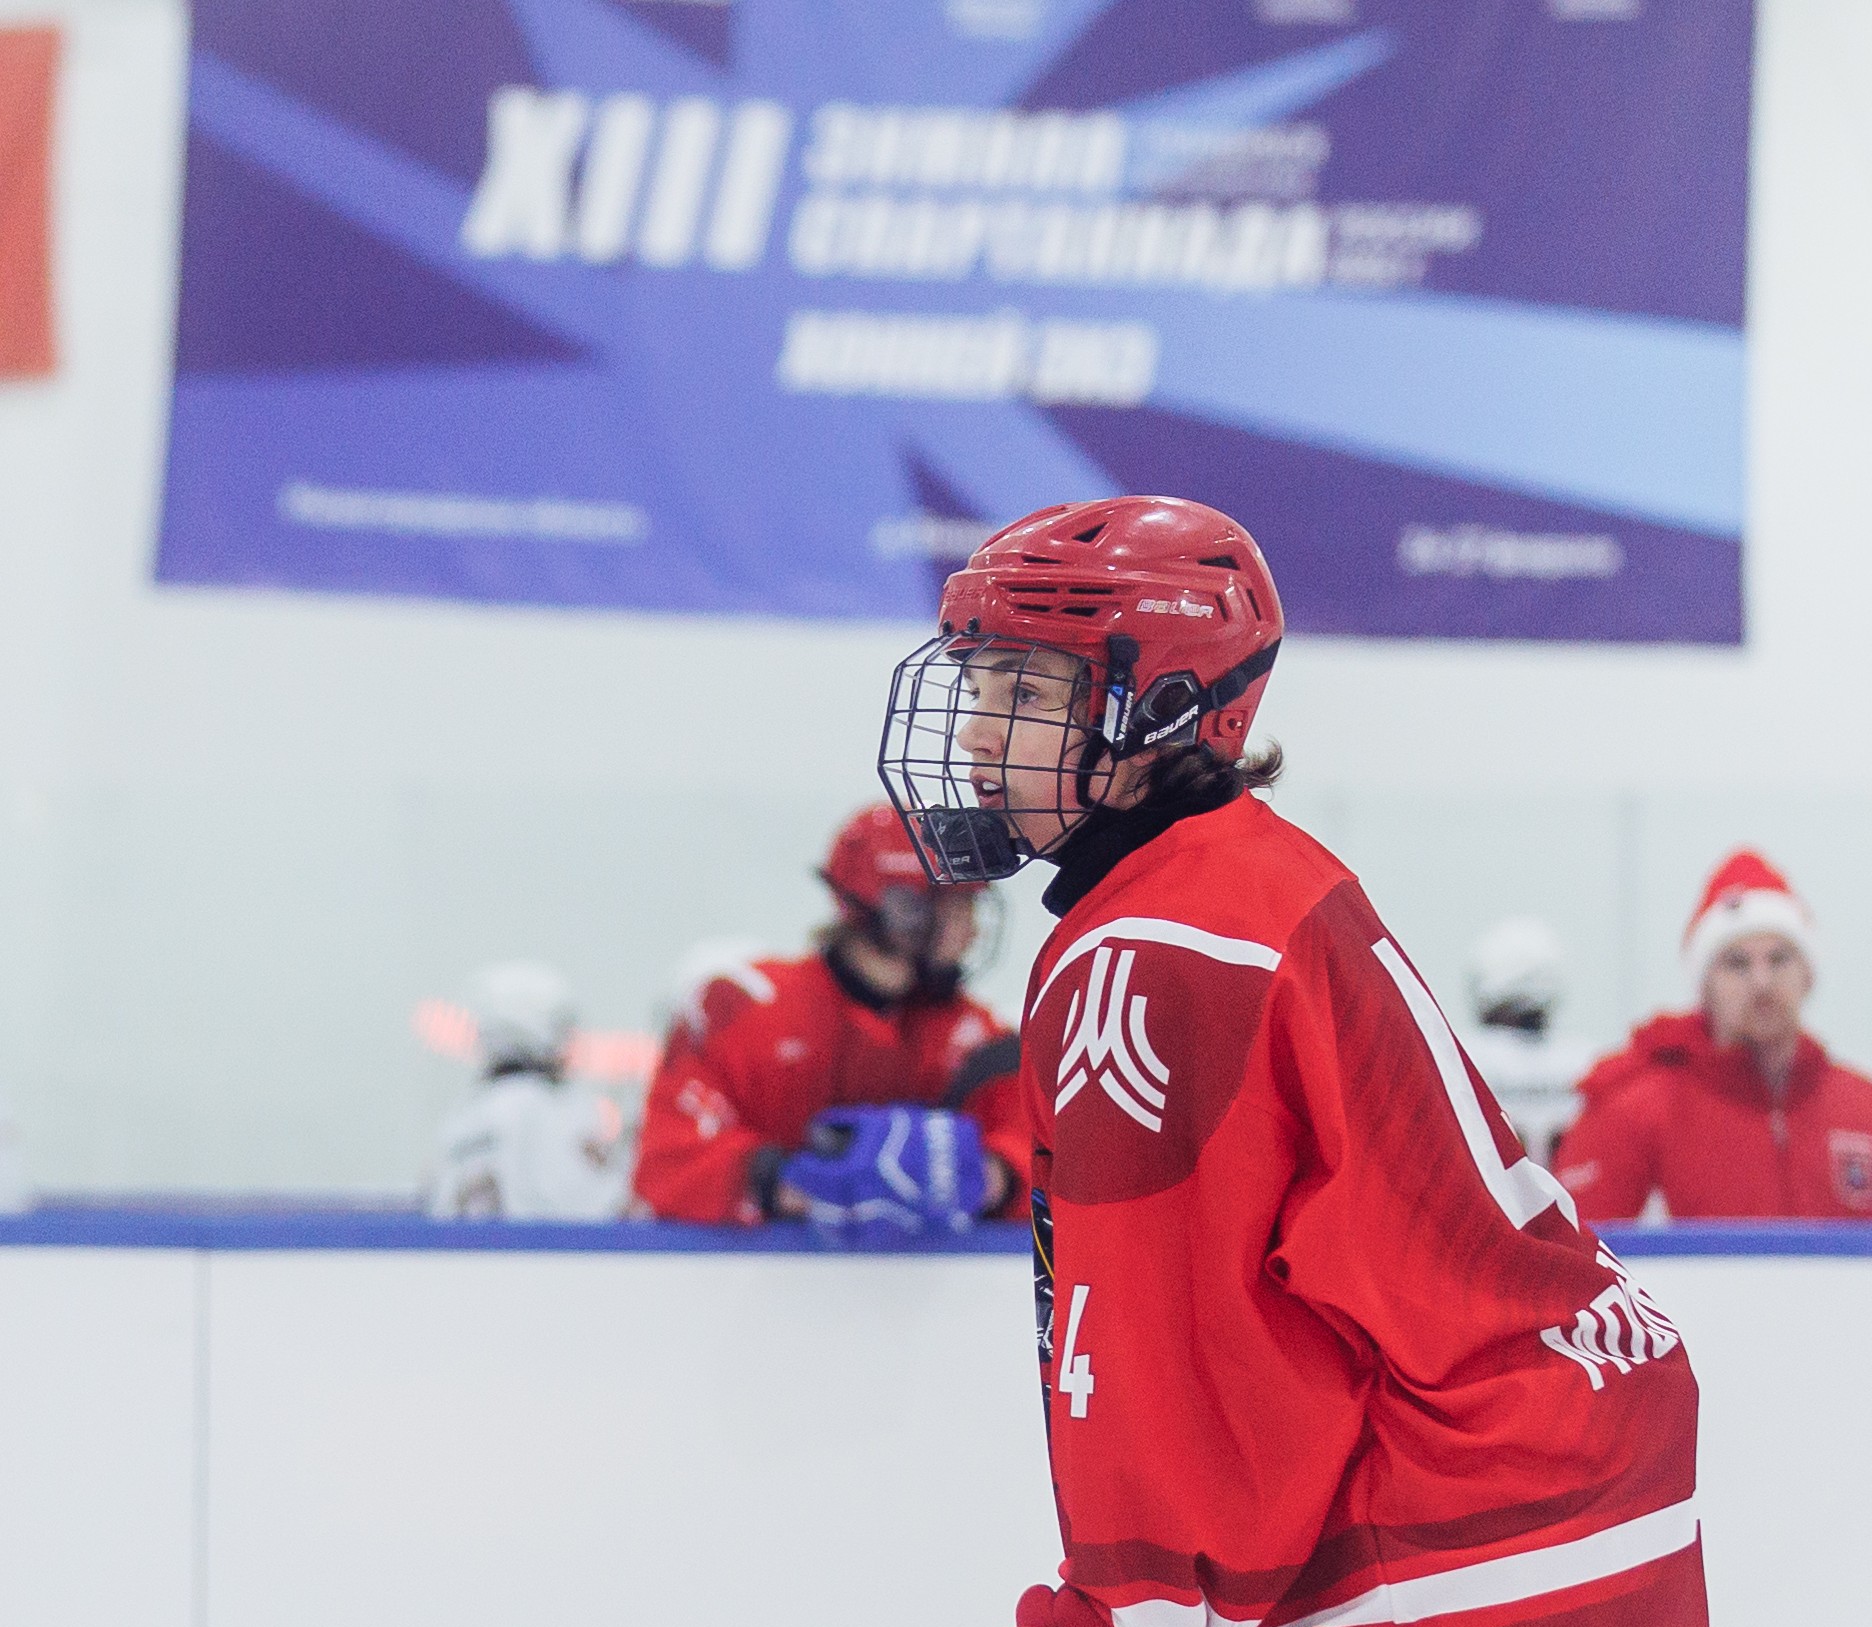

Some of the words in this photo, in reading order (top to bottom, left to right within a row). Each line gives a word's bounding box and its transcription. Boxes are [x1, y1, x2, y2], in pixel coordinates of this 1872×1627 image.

[461, 85, 792, 271] XIII
[1144, 704, 1199, 745] BAUER
[1058, 1284, 1095, 1419] 4
